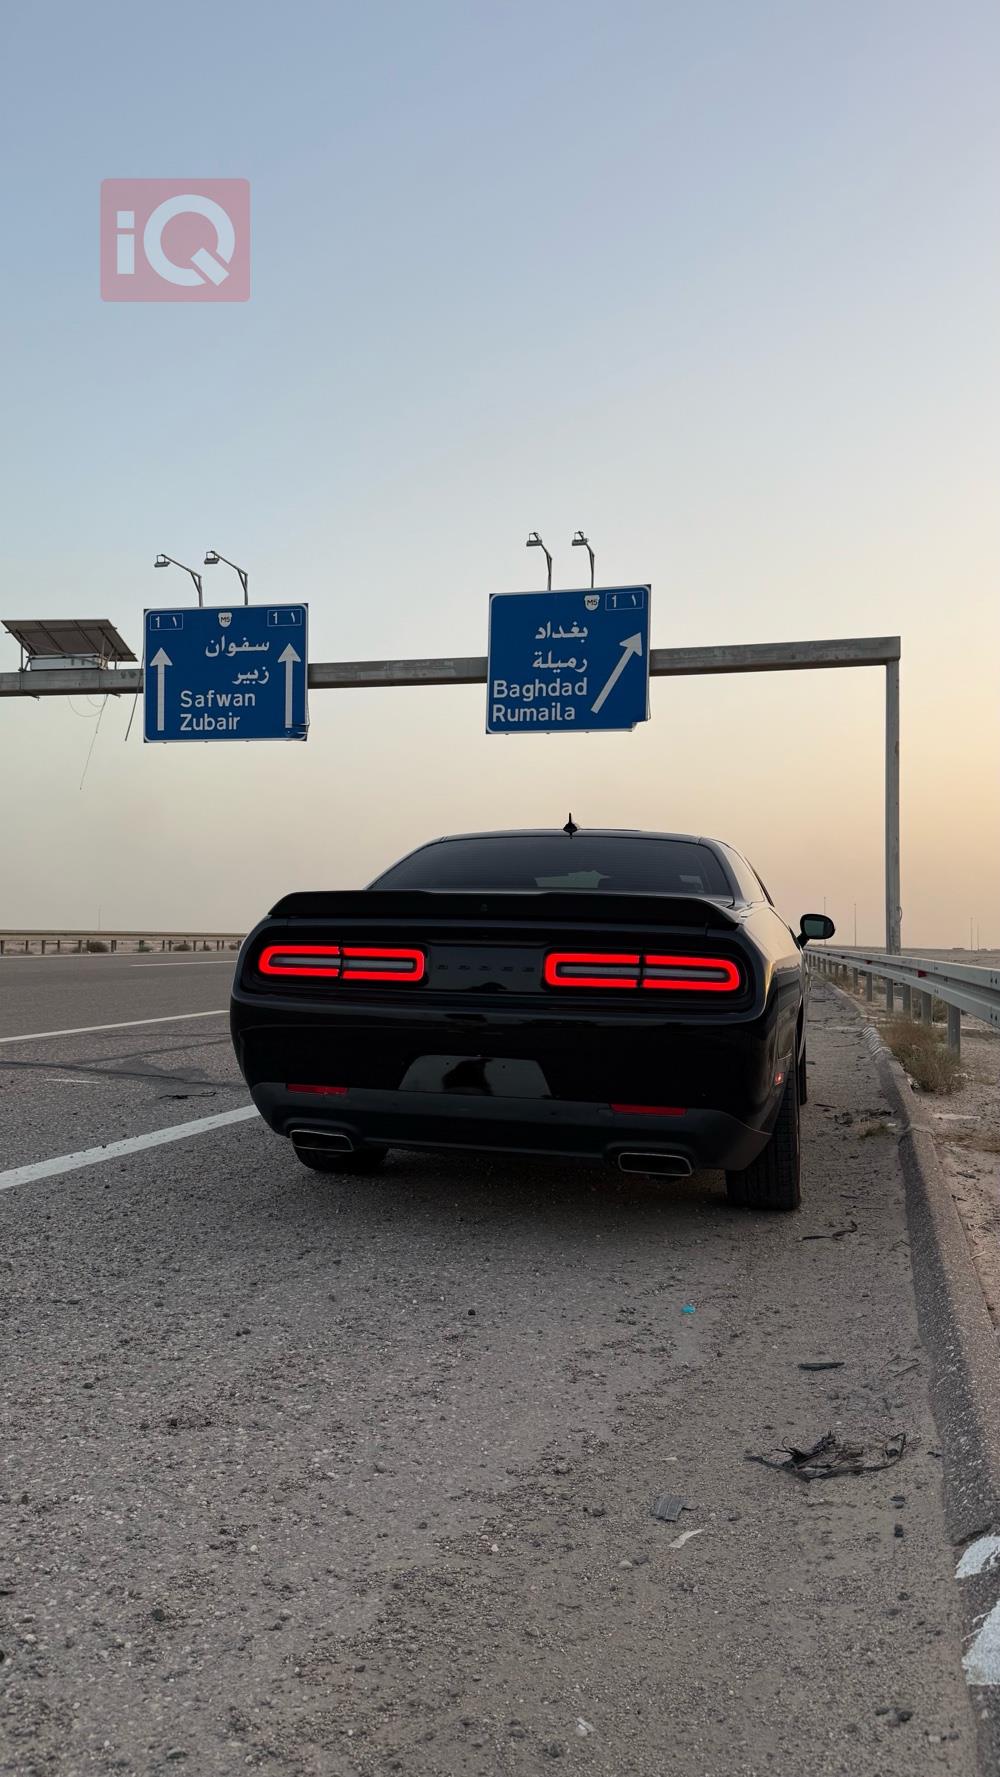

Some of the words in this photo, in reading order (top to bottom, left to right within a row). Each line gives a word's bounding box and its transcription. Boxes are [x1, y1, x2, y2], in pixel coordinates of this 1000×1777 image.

[535, 621, 589, 643] بغداد
[205, 635, 270, 657] سفوان
[532, 650, 588, 673] رميلة
[232, 666, 270, 685] زبير
[180, 690, 256, 708] Safwan
[493, 677, 588, 702] Baghdad
[180, 712, 241, 731] Zubair
[492, 702, 576, 723] Rumaila
